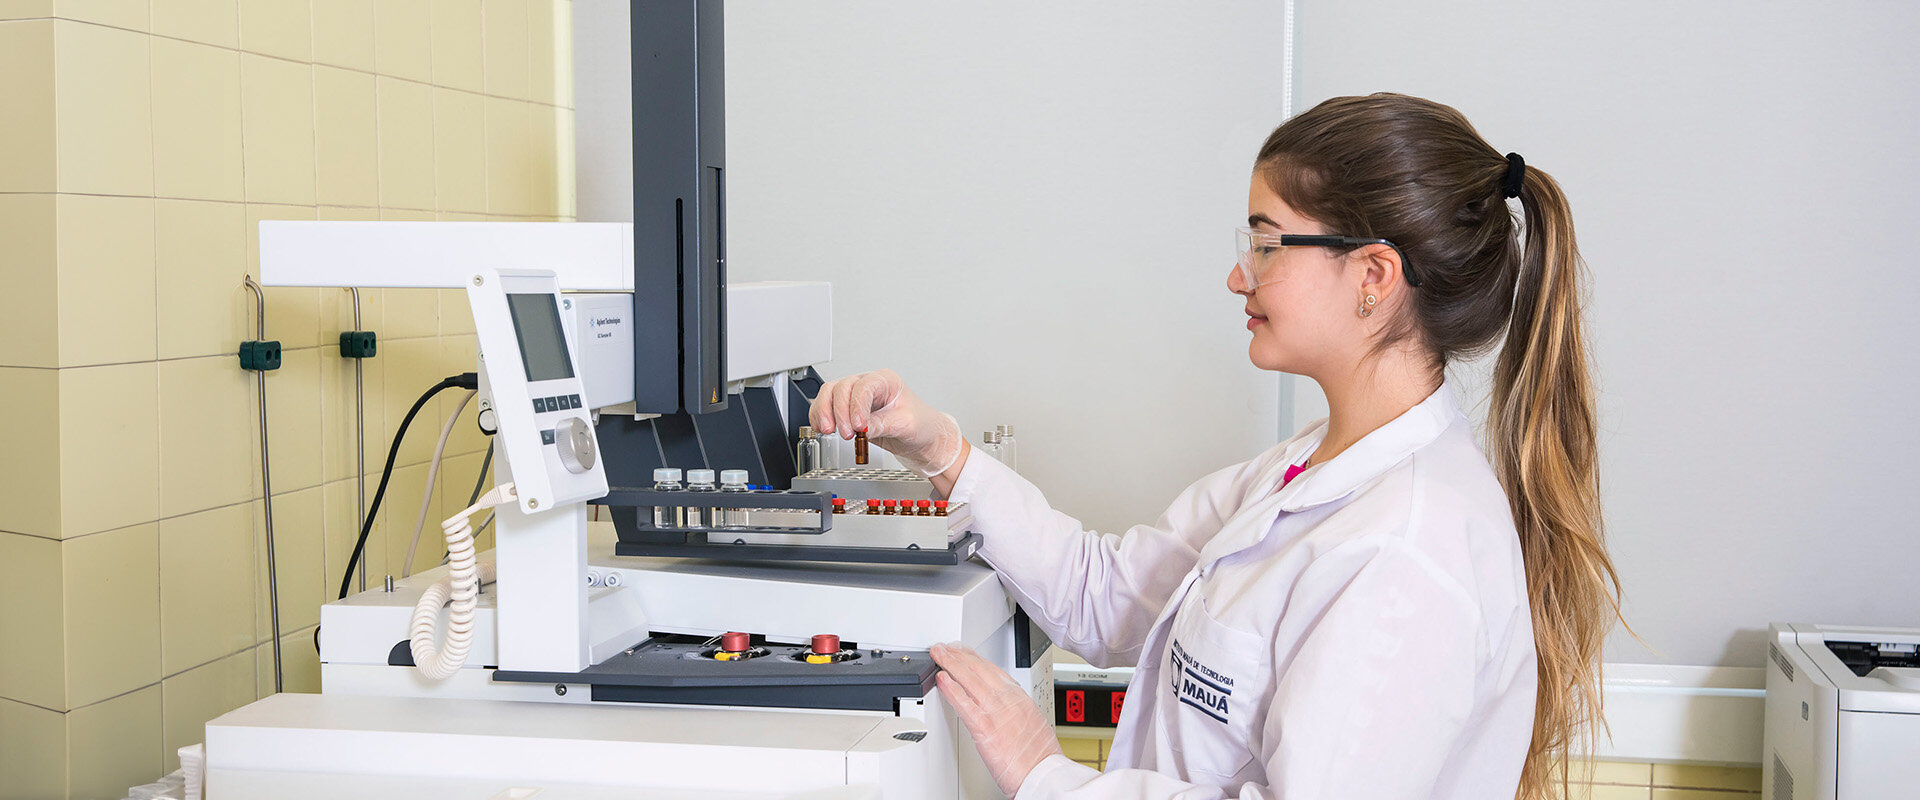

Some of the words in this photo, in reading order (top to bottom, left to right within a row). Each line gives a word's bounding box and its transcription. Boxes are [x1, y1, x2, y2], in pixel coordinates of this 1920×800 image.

[1193, 660, 1200, 670] DE
[1200, 664, 1234, 687] TECNOLOGIA
[1183, 678, 1229, 714] MAUÁ
